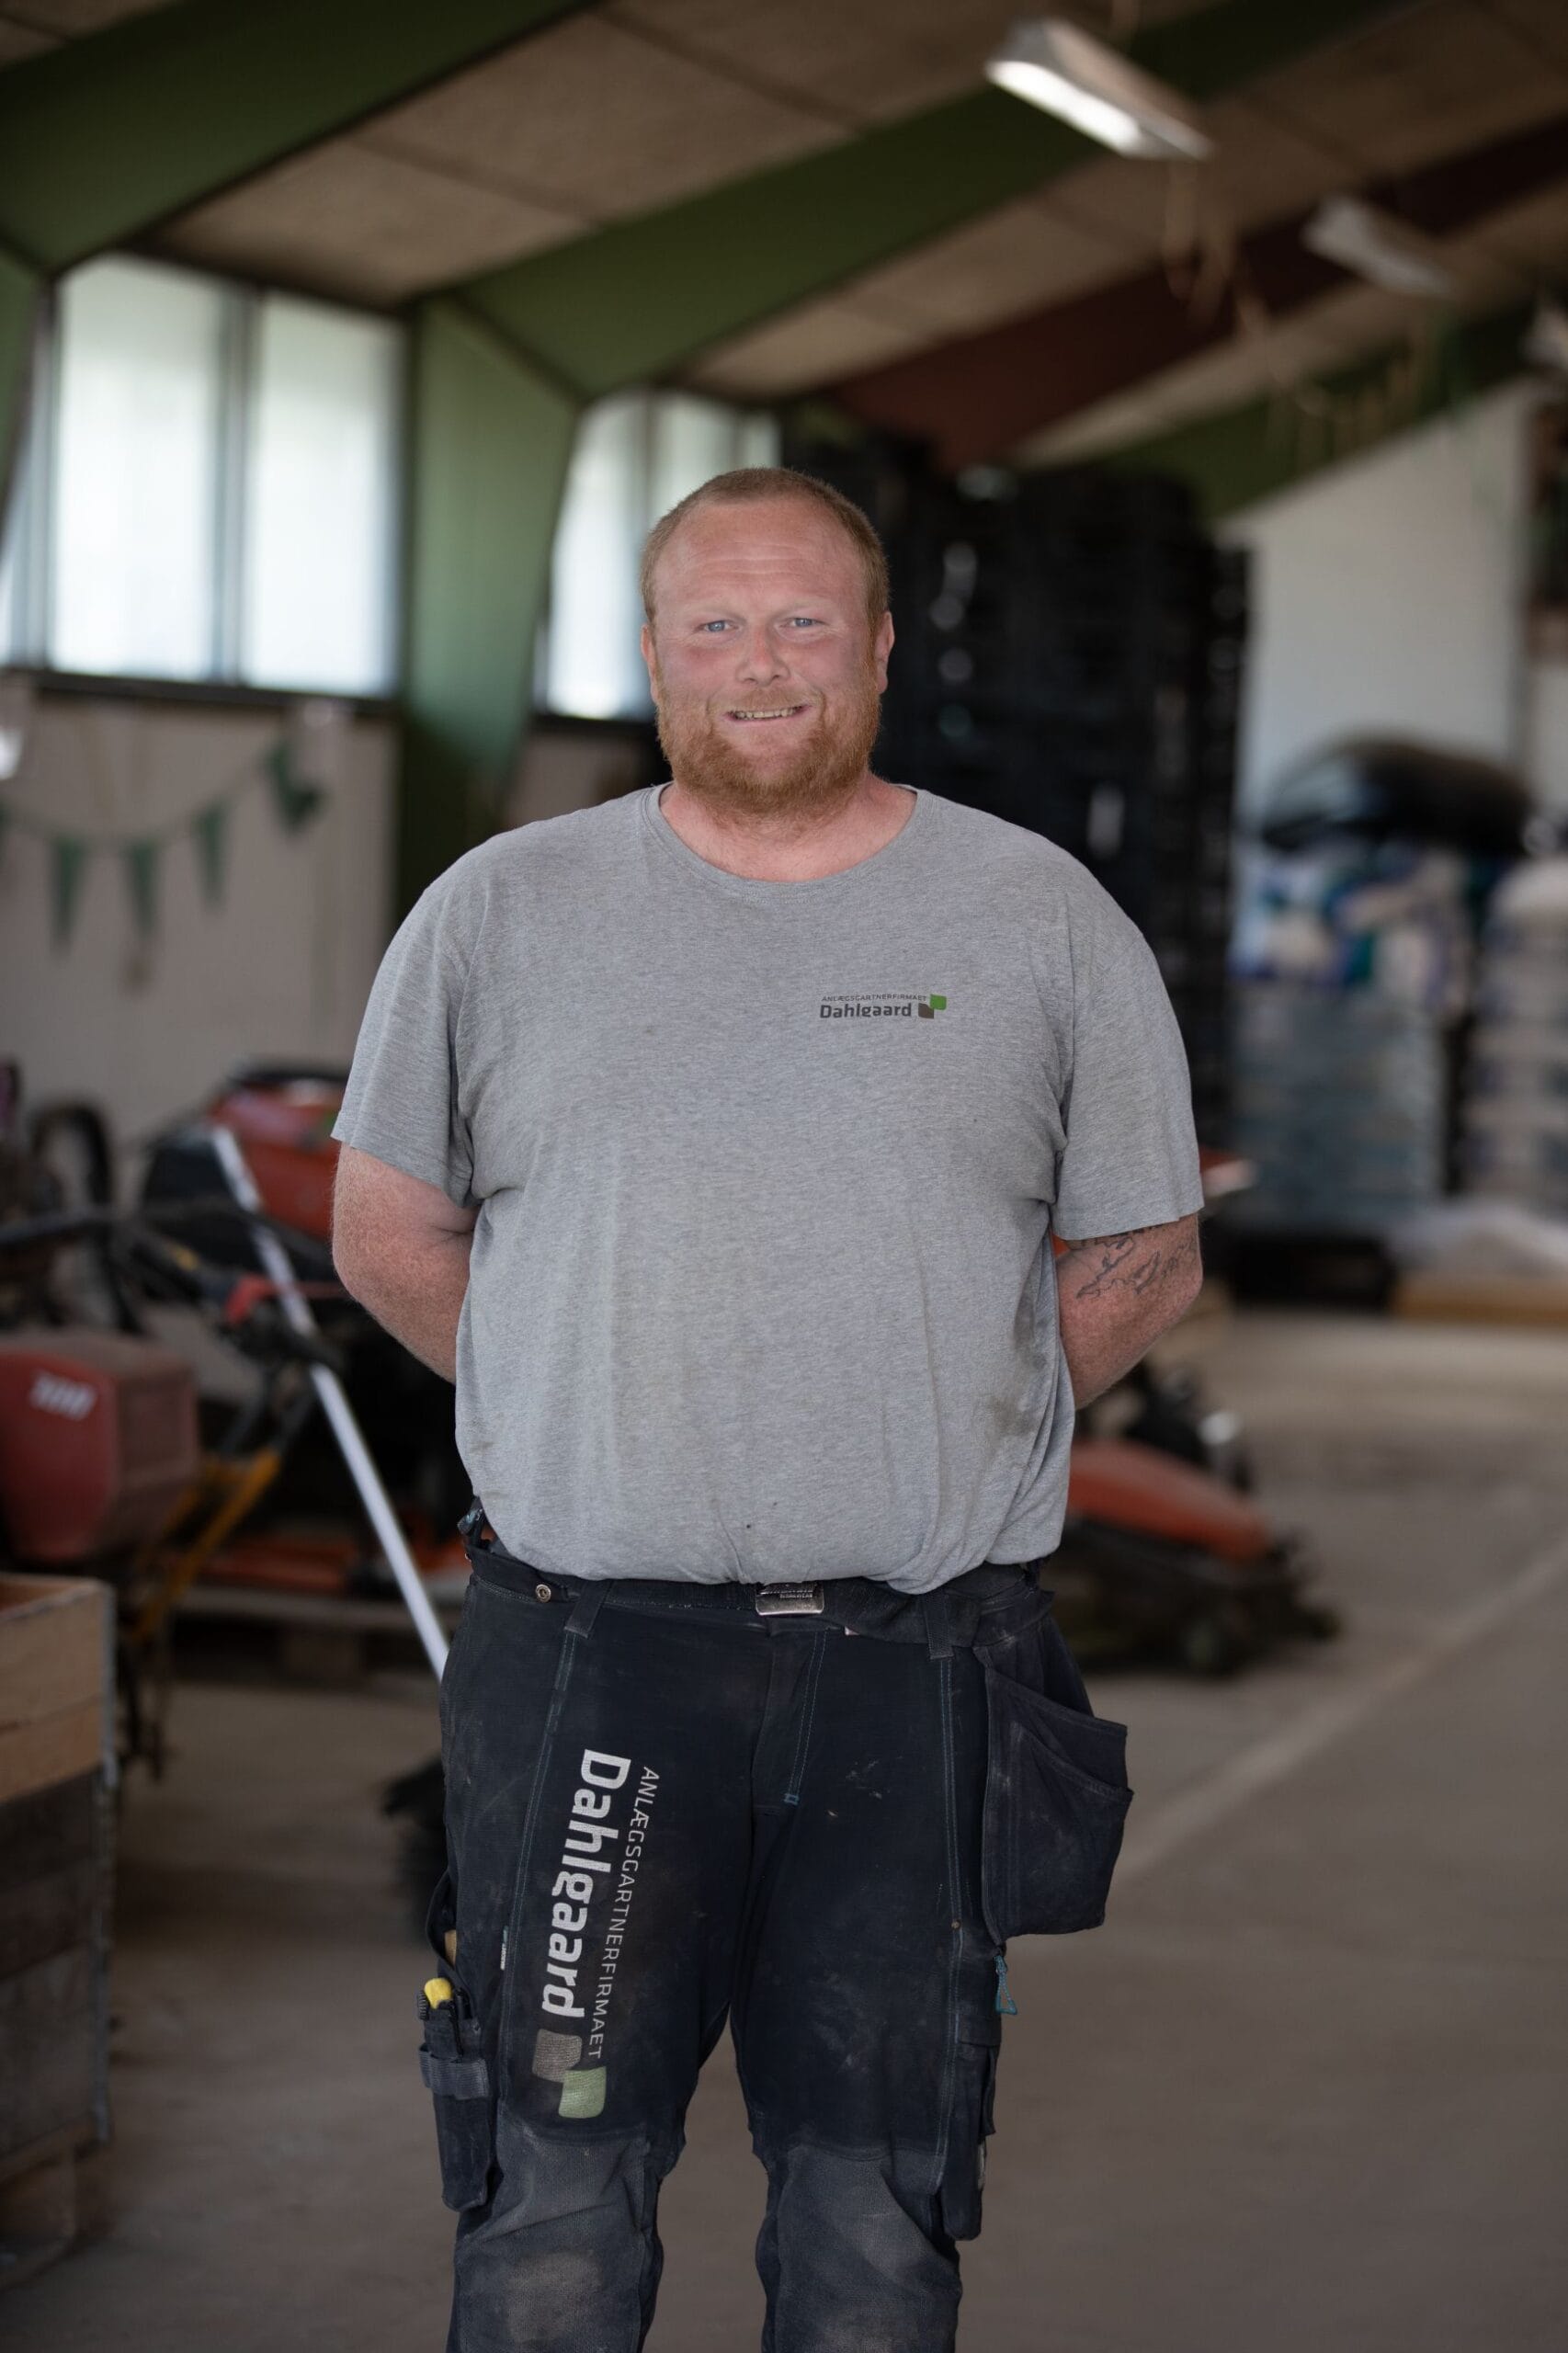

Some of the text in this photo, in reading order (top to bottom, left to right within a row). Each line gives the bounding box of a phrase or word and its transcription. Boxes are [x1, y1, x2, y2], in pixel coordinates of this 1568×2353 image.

[820, 1003, 912, 1018] Dahlgaard
[821, 994, 927, 1003] ANLÆGSGARTNERFIRMAET
[540, 1748, 632, 2018] Dahlgaard
[588, 1766, 660, 2060] ANLÆGSGARTNERFIRMAET
